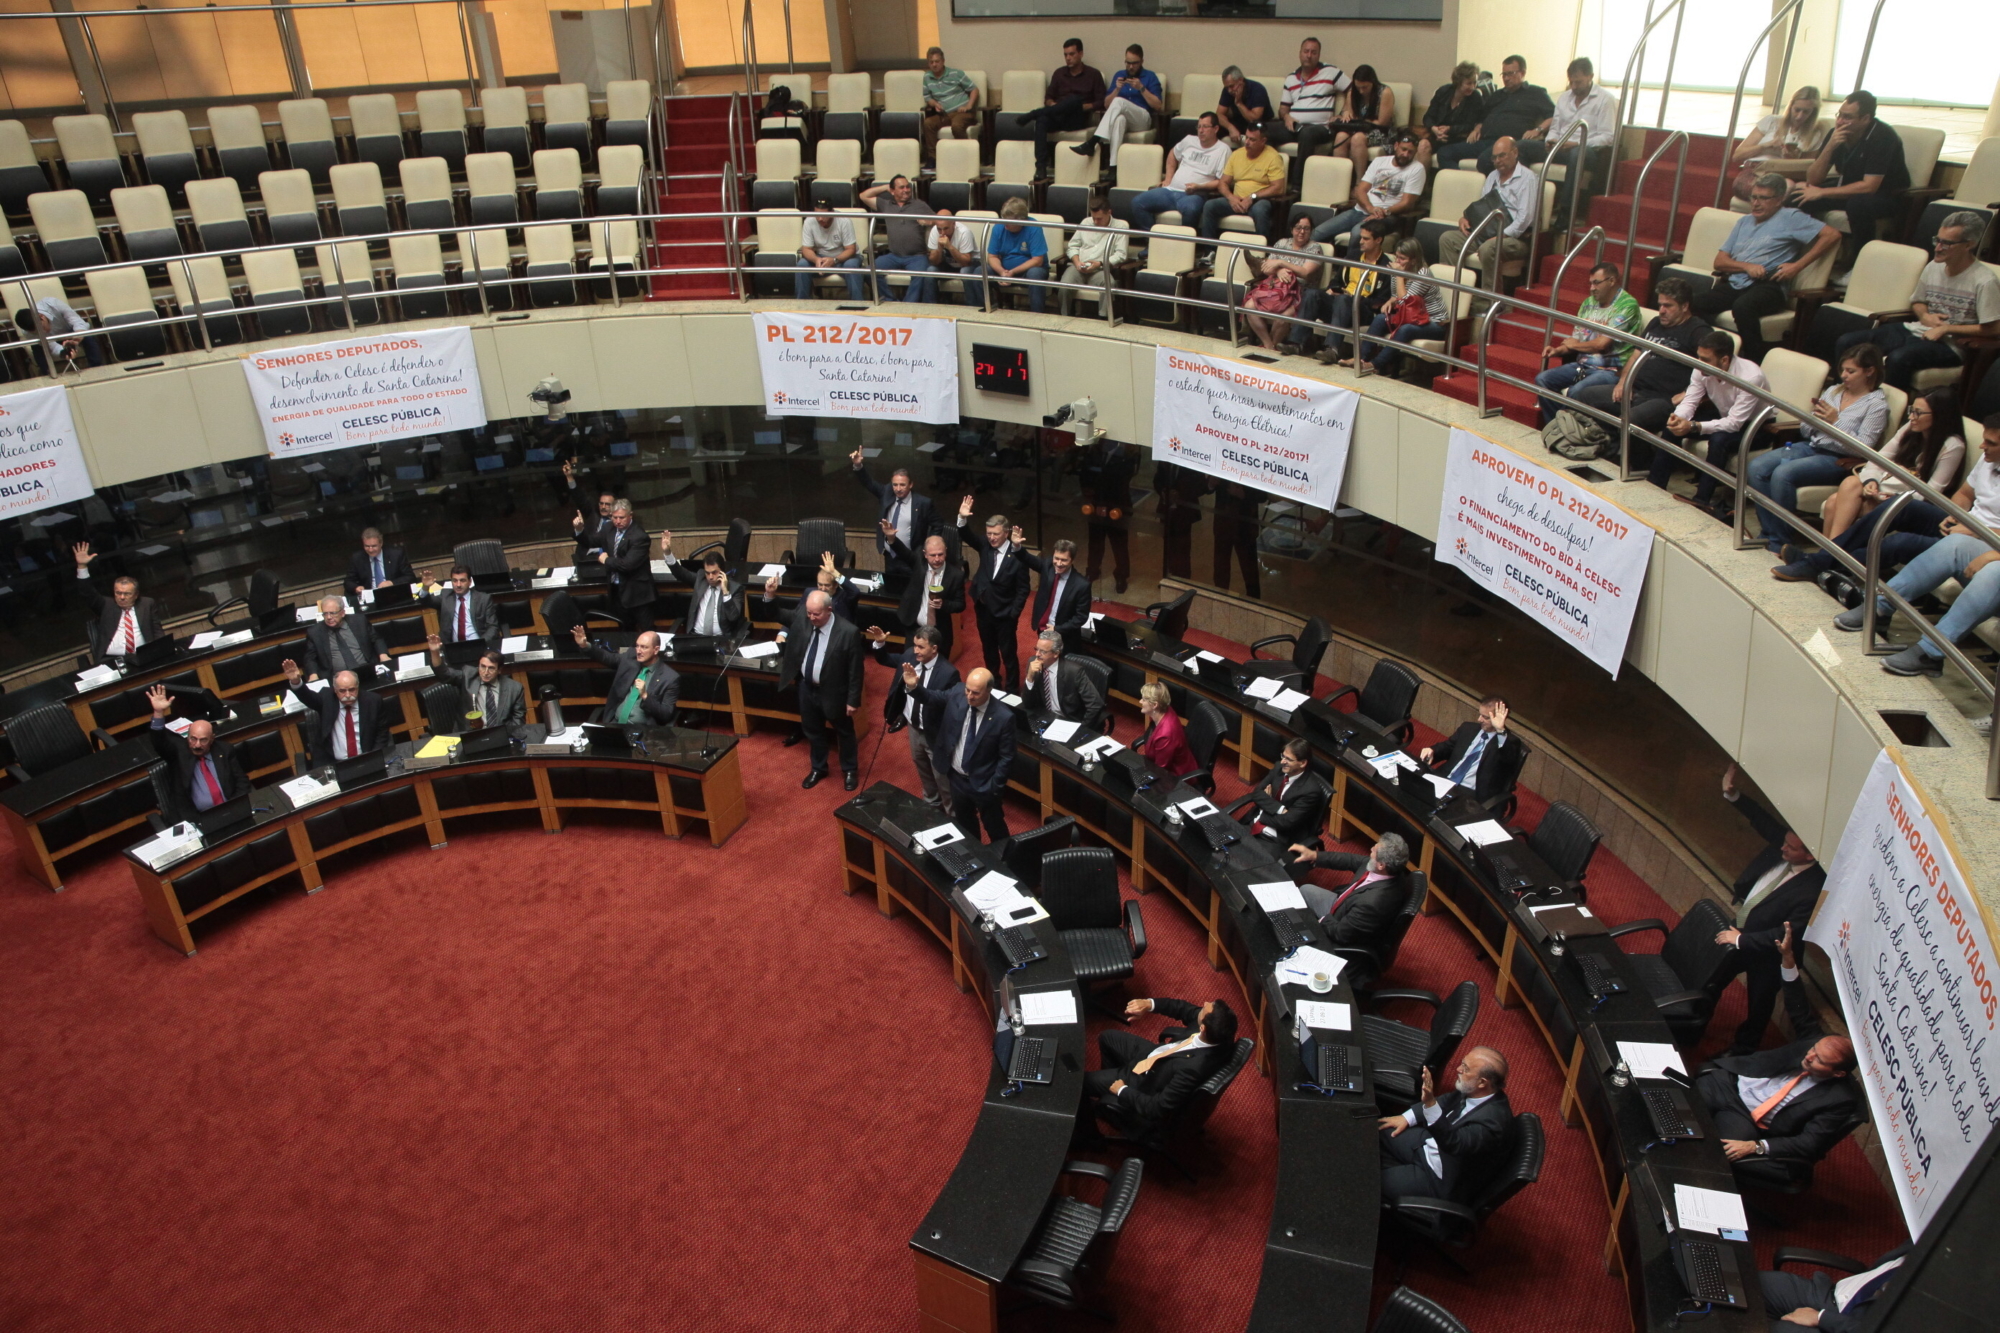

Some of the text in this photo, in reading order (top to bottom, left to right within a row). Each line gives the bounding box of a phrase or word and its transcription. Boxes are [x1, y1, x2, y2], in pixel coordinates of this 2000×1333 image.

[767, 322, 912, 346] PL 212/2017
[256, 339, 422, 370] SENHORES DEPUTADOS,
[779, 351, 785, 361] é
[786, 348, 808, 362] bom
[809, 354, 834, 369] para
[844, 351, 878, 365] Celesc,
[880, 353, 887, 364] é
[887, 351, 910, 365] bom
[910, 357, 935, 373] para
[282, 355, 444, 389] Defender a Celesc é defender o
[819, 369, 897, 383] Santa Catarina!
[1169, 356, 1311, 402] SENHORES DEPUTADOS,
[270, 369, 463, 410] desenvolvimento de Santa Catarina!
[272, 412, 311, 423] ENERGIA
[313, 408, 324, 416] DE
[326, 401, 375, 415] QUALIDADE
[377, 396, 399, 406] PARA
[401, 394, 424, 402] TODO
[435, 388, 468, 398] ESTADO
[788, 397, 820, 406] Intercel
[830, 391, 918, 403] CELESC PÚBLICA
[1168, 377, 1345, 430] o estado quer mais investimentos em
[342, 407, 441, 430] CELESC PÚBLICA
[831, 402, 922, 416] Bom para todo mundo!
[1212, 405, 1294, 438] Energia Elétrica!
[17, 422, 41, 442] que
[30, 438, 63, 452] como
[296, 432, 333, 445] Intercel
[346, 417, 446, 441] Bom para todo mundo!
[1195, 423, 1309, 464] APROVEM O PL 212/2017!
[1181, 446, 1211, 462] Intercel
[1222, 449, 1261, 468] CELESC
[1263, 461, 1309, 483] PÚBLICA
[0, 480, 44, 497] BLICA
[1221, 460, 1241, 474] Bom
[1239, 471, 1260, 482] para
[1260, 472, 1278, 486] todo
[1279, 481, 1312, 496] mundo!
[1472, 449, 1628, 541] APROVEM O PL 212/2017
[10, 489, 50, 508] mundo!
[1497, 487, 1594, 552] chega de desculpas!
[1458, 510, 1464, 522] É
[1466, 517, 1484, 535] MAIS
[1486, 529, 1553, 574] INVESTIMENTO
[1554, 569, 1579, 589] PARA
[1581, 586, 1598, 604] SC!
[1460, 496, 1621, 598] O FINANCIAMENTO DO BID À CELESC
[1466, 550, 1494, 576] Intercel
[1503, 577, 1591, 644] Bom para todo mundo!
[1505, 564, 1545, 596] CELESC
[1545, 587, 1589, 628] PÚBLICA
[1886, 780, 1998, 1031] SENHORES DEPUTADOS,
[1873, 823, 1897, 881] ajudem
[1896, 878, 1905, 894] a
[1905, 884, 1933, 947] Celesc
[1930, 944, 1938, 961] a
[1936, 958, 1974, 1051] continuar
[1844, 948, 1862, 1004] Intercel
[1868, 873, 1974, 1144] energia de qualidade para toda
[1872, 952, 1938, 1102] Santa Catarina!
[1869, 1000, 1932, 1178] CELESC PÚBLICA
[1861, 1019, 1925, 1203] Bom para todo mundo!
